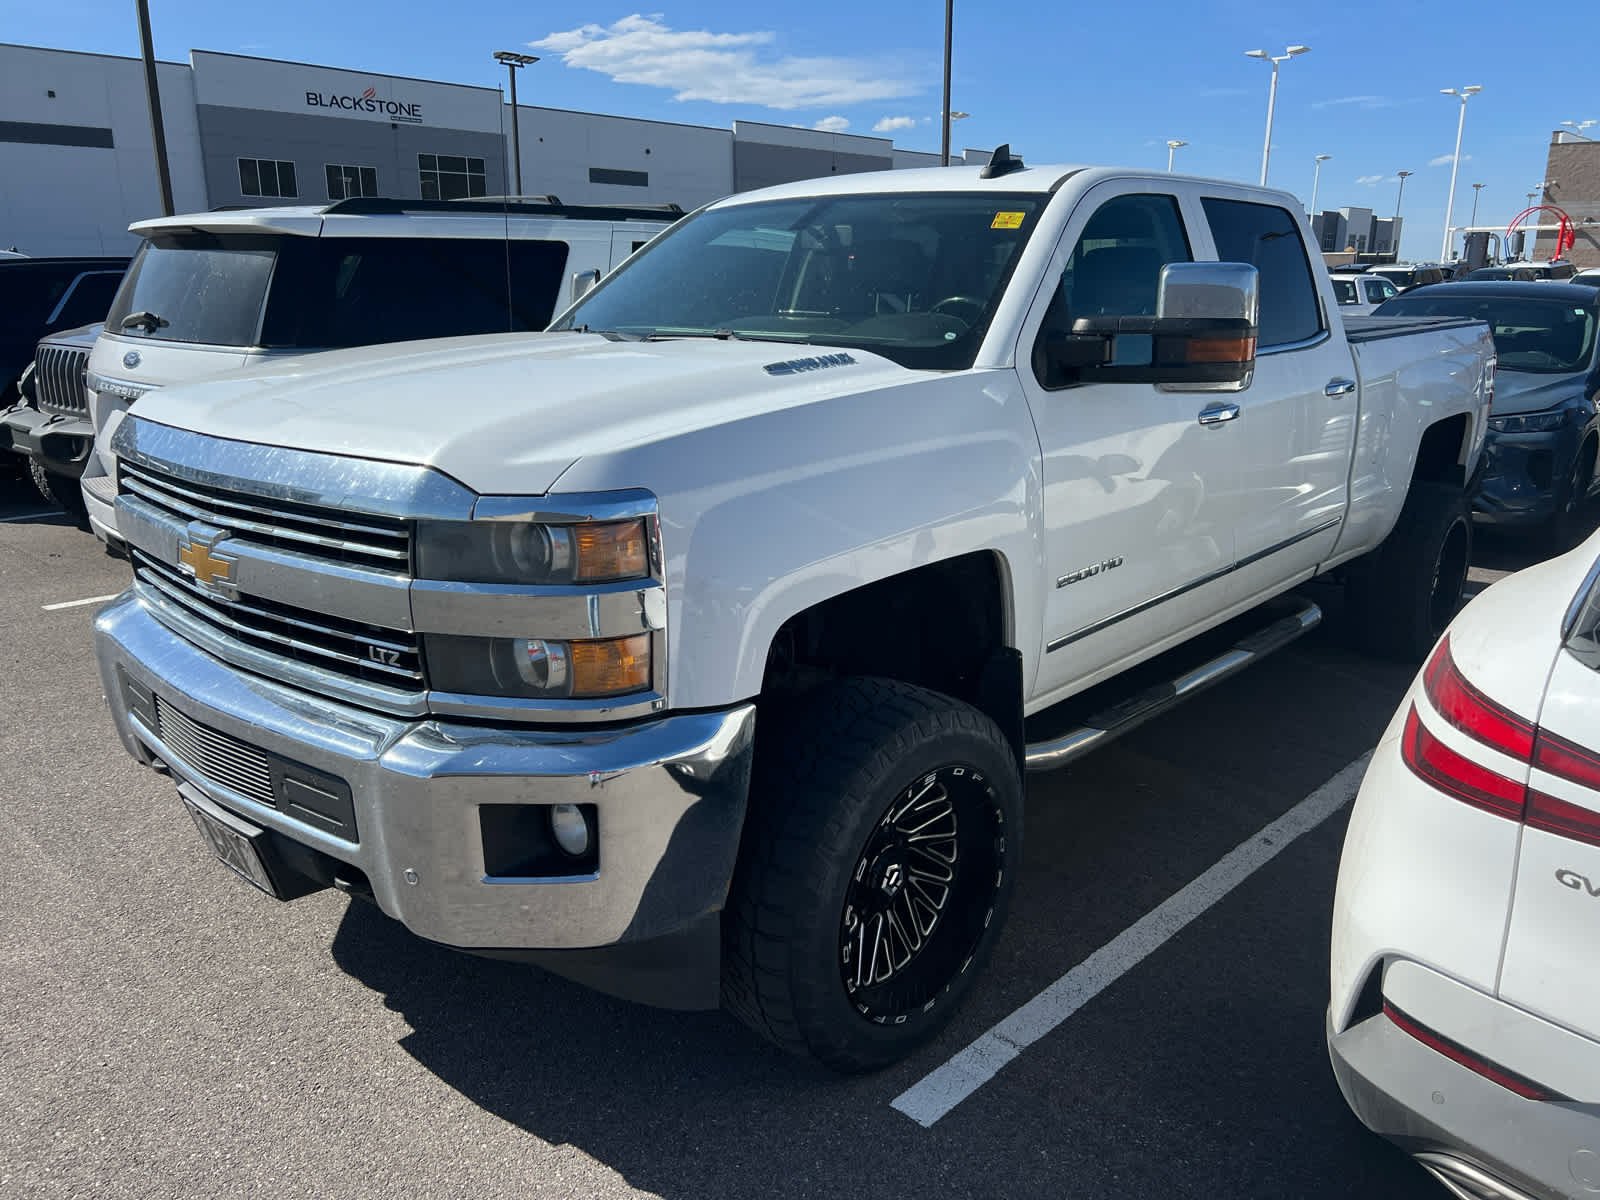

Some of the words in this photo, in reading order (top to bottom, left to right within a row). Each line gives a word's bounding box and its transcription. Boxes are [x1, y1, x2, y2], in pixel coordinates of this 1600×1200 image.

[306, 92, 422, 117] BLACKSTONE
[1101, 555, 1123, 572] HD
[369, 645, 401, 667] LTZ
